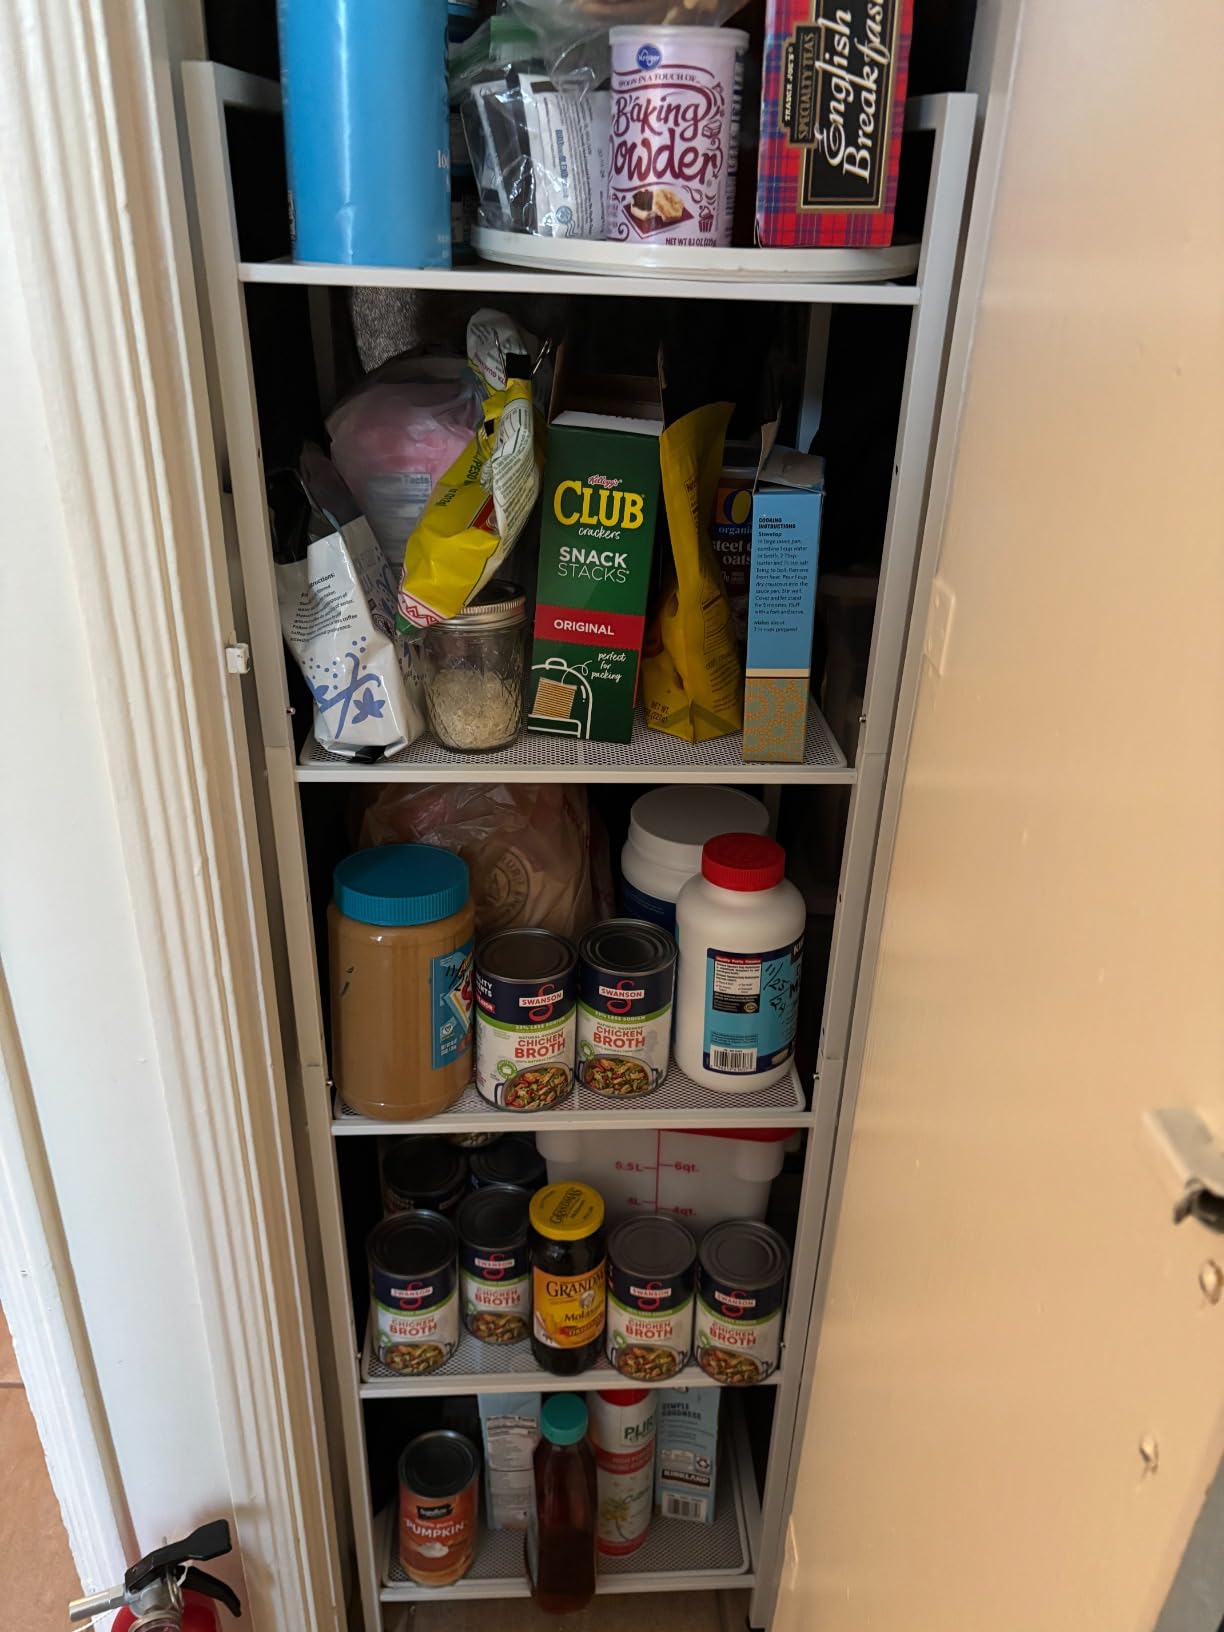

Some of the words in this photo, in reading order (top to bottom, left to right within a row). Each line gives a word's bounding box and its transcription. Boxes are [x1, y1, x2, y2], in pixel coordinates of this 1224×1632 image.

[814, 8, 854, 167] English
[842, 0, 890, 184] Breakfas
[613, 96, 701, 142] Baking
[612, 128, 718, 185] owder
[553, 480, 645, 529] CLUB
[578, 526, 621, 540] crackers
[559, 546, 628, 569] SNACK
[557, 562, 628, 584] STACKS
[553, 619, 615, 636] ORIGINAL
[597, 652, 627, 663] perfect
[600, 662, 612, 671] for
[591, 671, 622, 683] packing
[521, 992, 564, 1006] SWANSON
[600, 987, 644, 999] SWANSON
[518, 1030, 565, 1048] CHICKEN
[595, 1025, 644, 1038] CHICKEN
[592, 1032, 647, 1049] BROTH
[513, 1038, 567, 1060] BROTH
[474, 1293, 521, 1306] BROTH
[476, 1287, 518, 1298] CHICKEN
[389, 1322, 437, 1337] BROTH
[391, 1318, 435, 1329] CHICKEN
[625, 1324, 673, 1339] BROTH
[627, 1319, 672, 1331] CHICKEN
[711, 1321, 755, 1337] CHICKEN
[709, 1327, 757, 1346] BROTH
[405, 1518, 465, 1538] PUMPKIN
